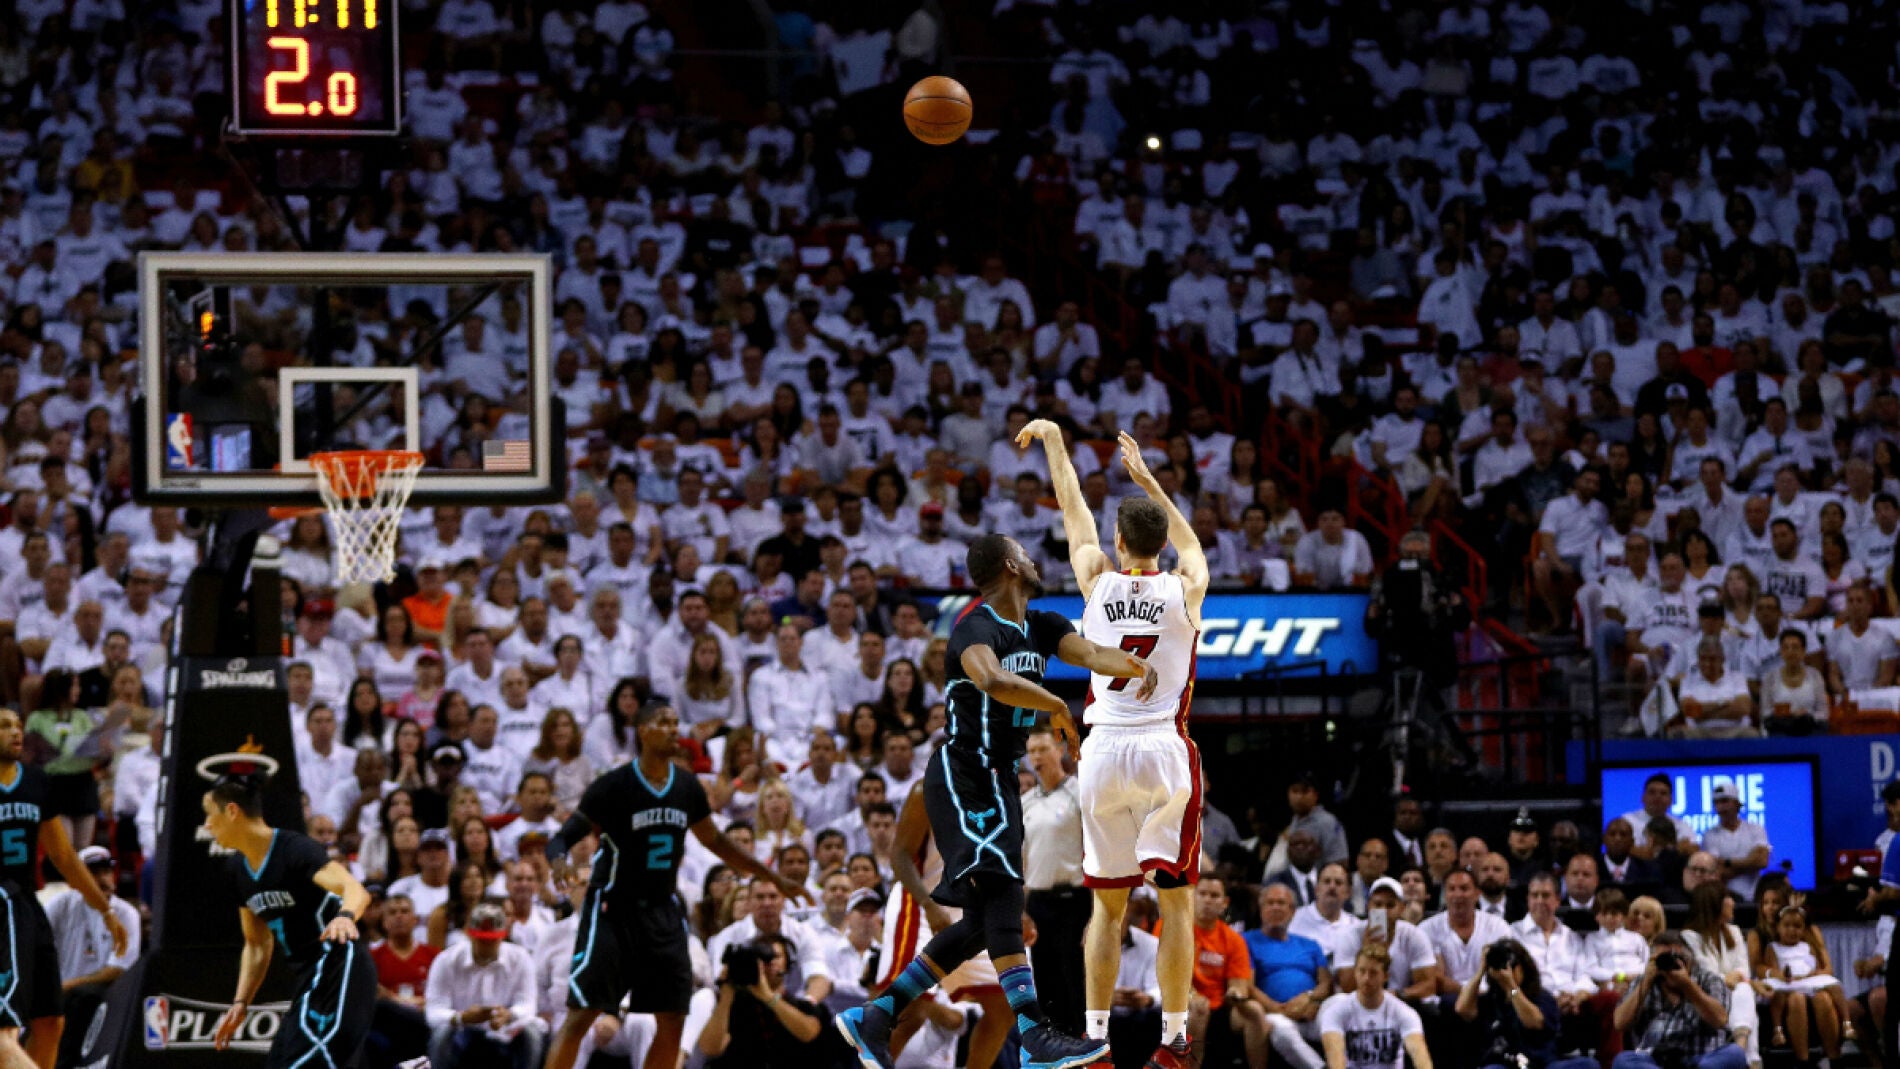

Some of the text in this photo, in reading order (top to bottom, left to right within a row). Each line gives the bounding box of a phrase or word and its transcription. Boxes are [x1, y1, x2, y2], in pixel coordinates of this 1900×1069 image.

[264, 37, 357, 116] 2.0
[1104, 600, 1165, 624] DRAGIĆ
[1196, 617, 1341, 656] GHT
[201, 669, 276, 689] SPALDING
[1107, 635, 1160, 692] 7
[647, 834, 674, 869] 2
